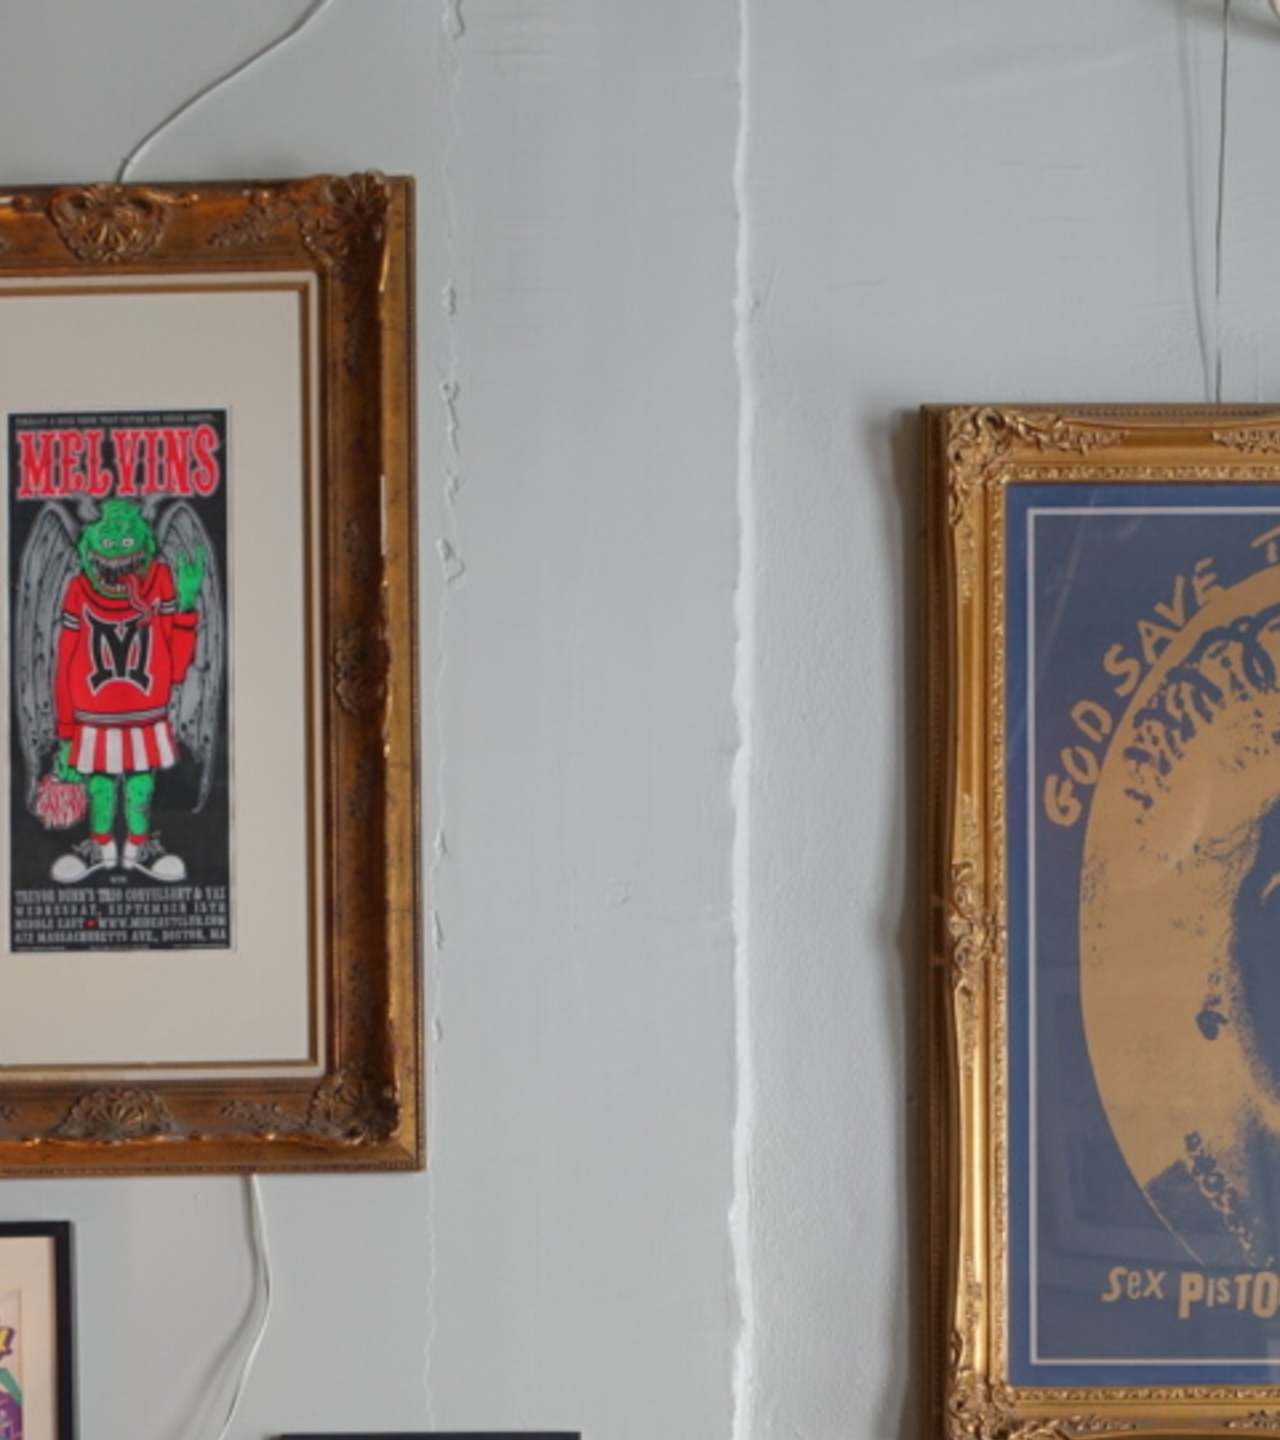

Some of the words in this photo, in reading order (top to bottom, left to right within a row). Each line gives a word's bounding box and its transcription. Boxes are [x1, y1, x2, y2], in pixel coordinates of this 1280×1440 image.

[16, 425, 221, 499] MELVINS
[1044, 699, 1113, 828] GOD
[1103, 556, 1226, 695] SAVE
